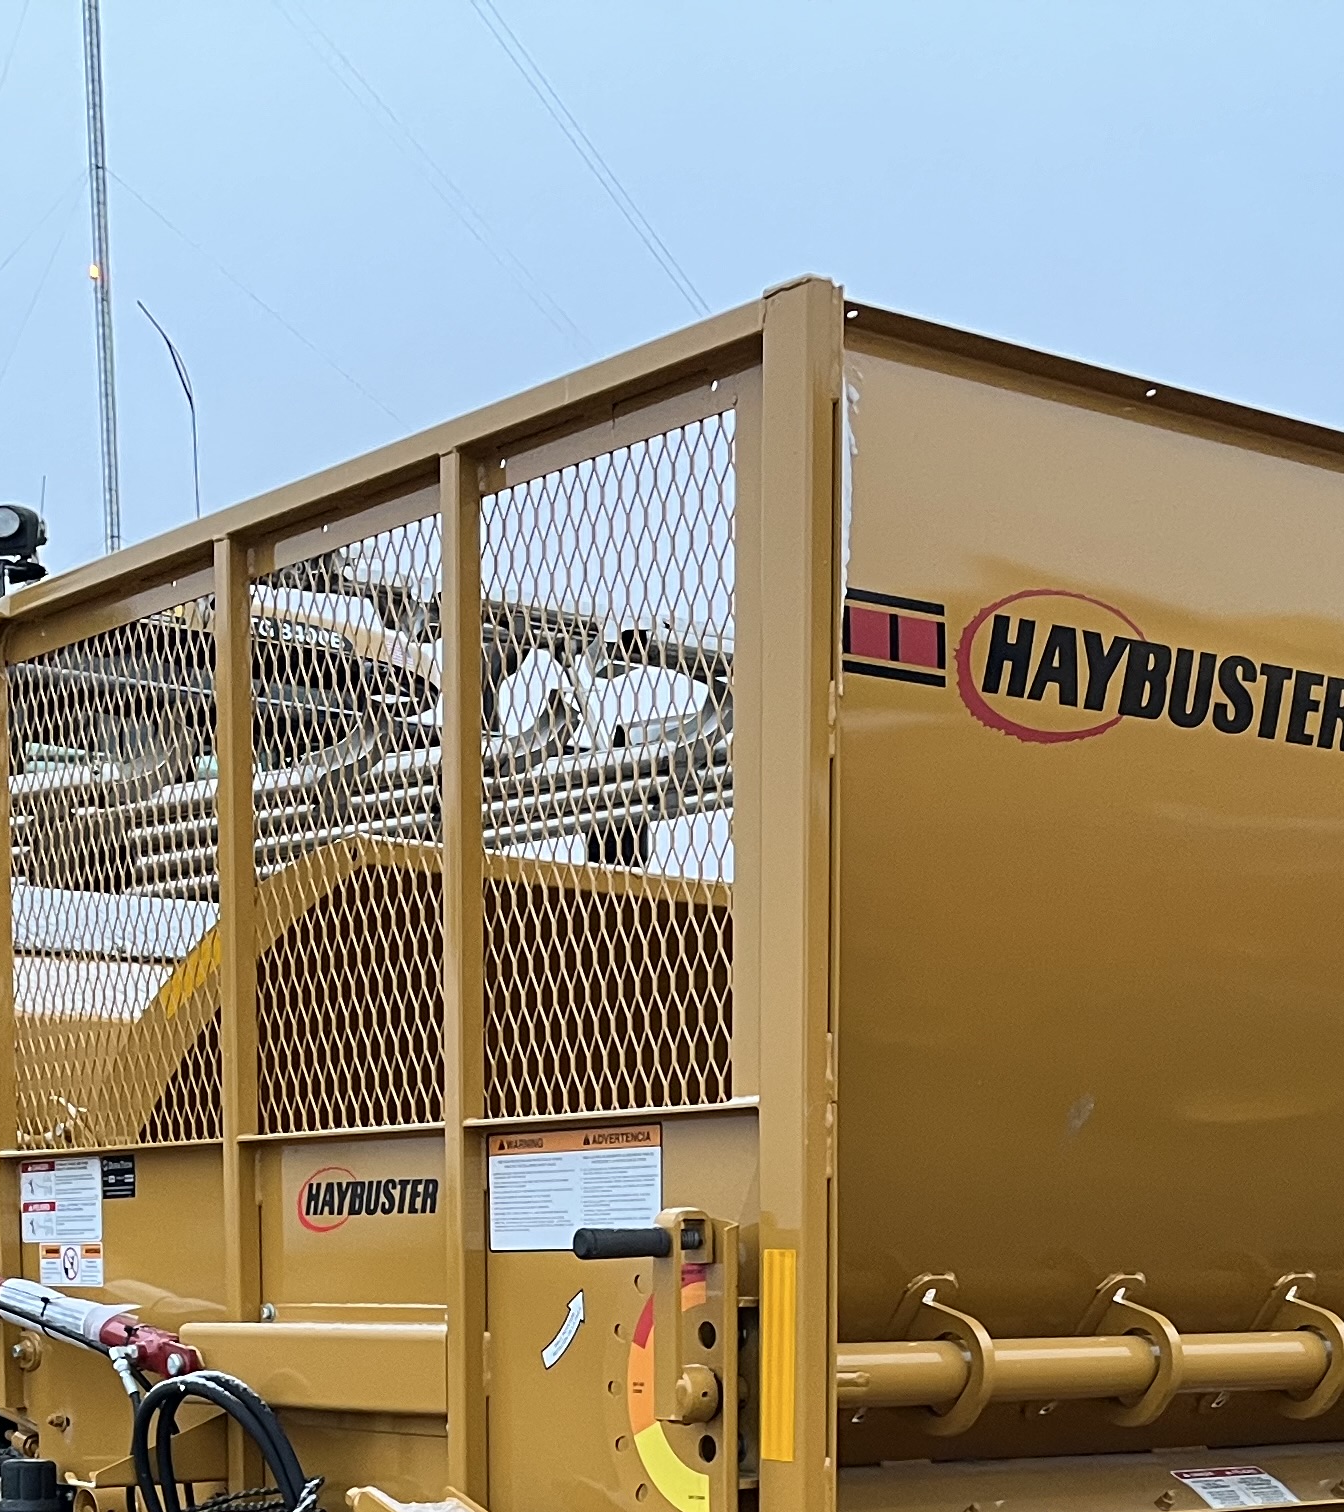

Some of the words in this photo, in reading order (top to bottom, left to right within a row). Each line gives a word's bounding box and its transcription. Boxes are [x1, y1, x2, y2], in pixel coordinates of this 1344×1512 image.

[505, 1137, 545, 1150] WARNING
[591, 1130, 652, 1146] ADVERTENCIA
[304, 1178, 439, 1217] HAYBUSTER
